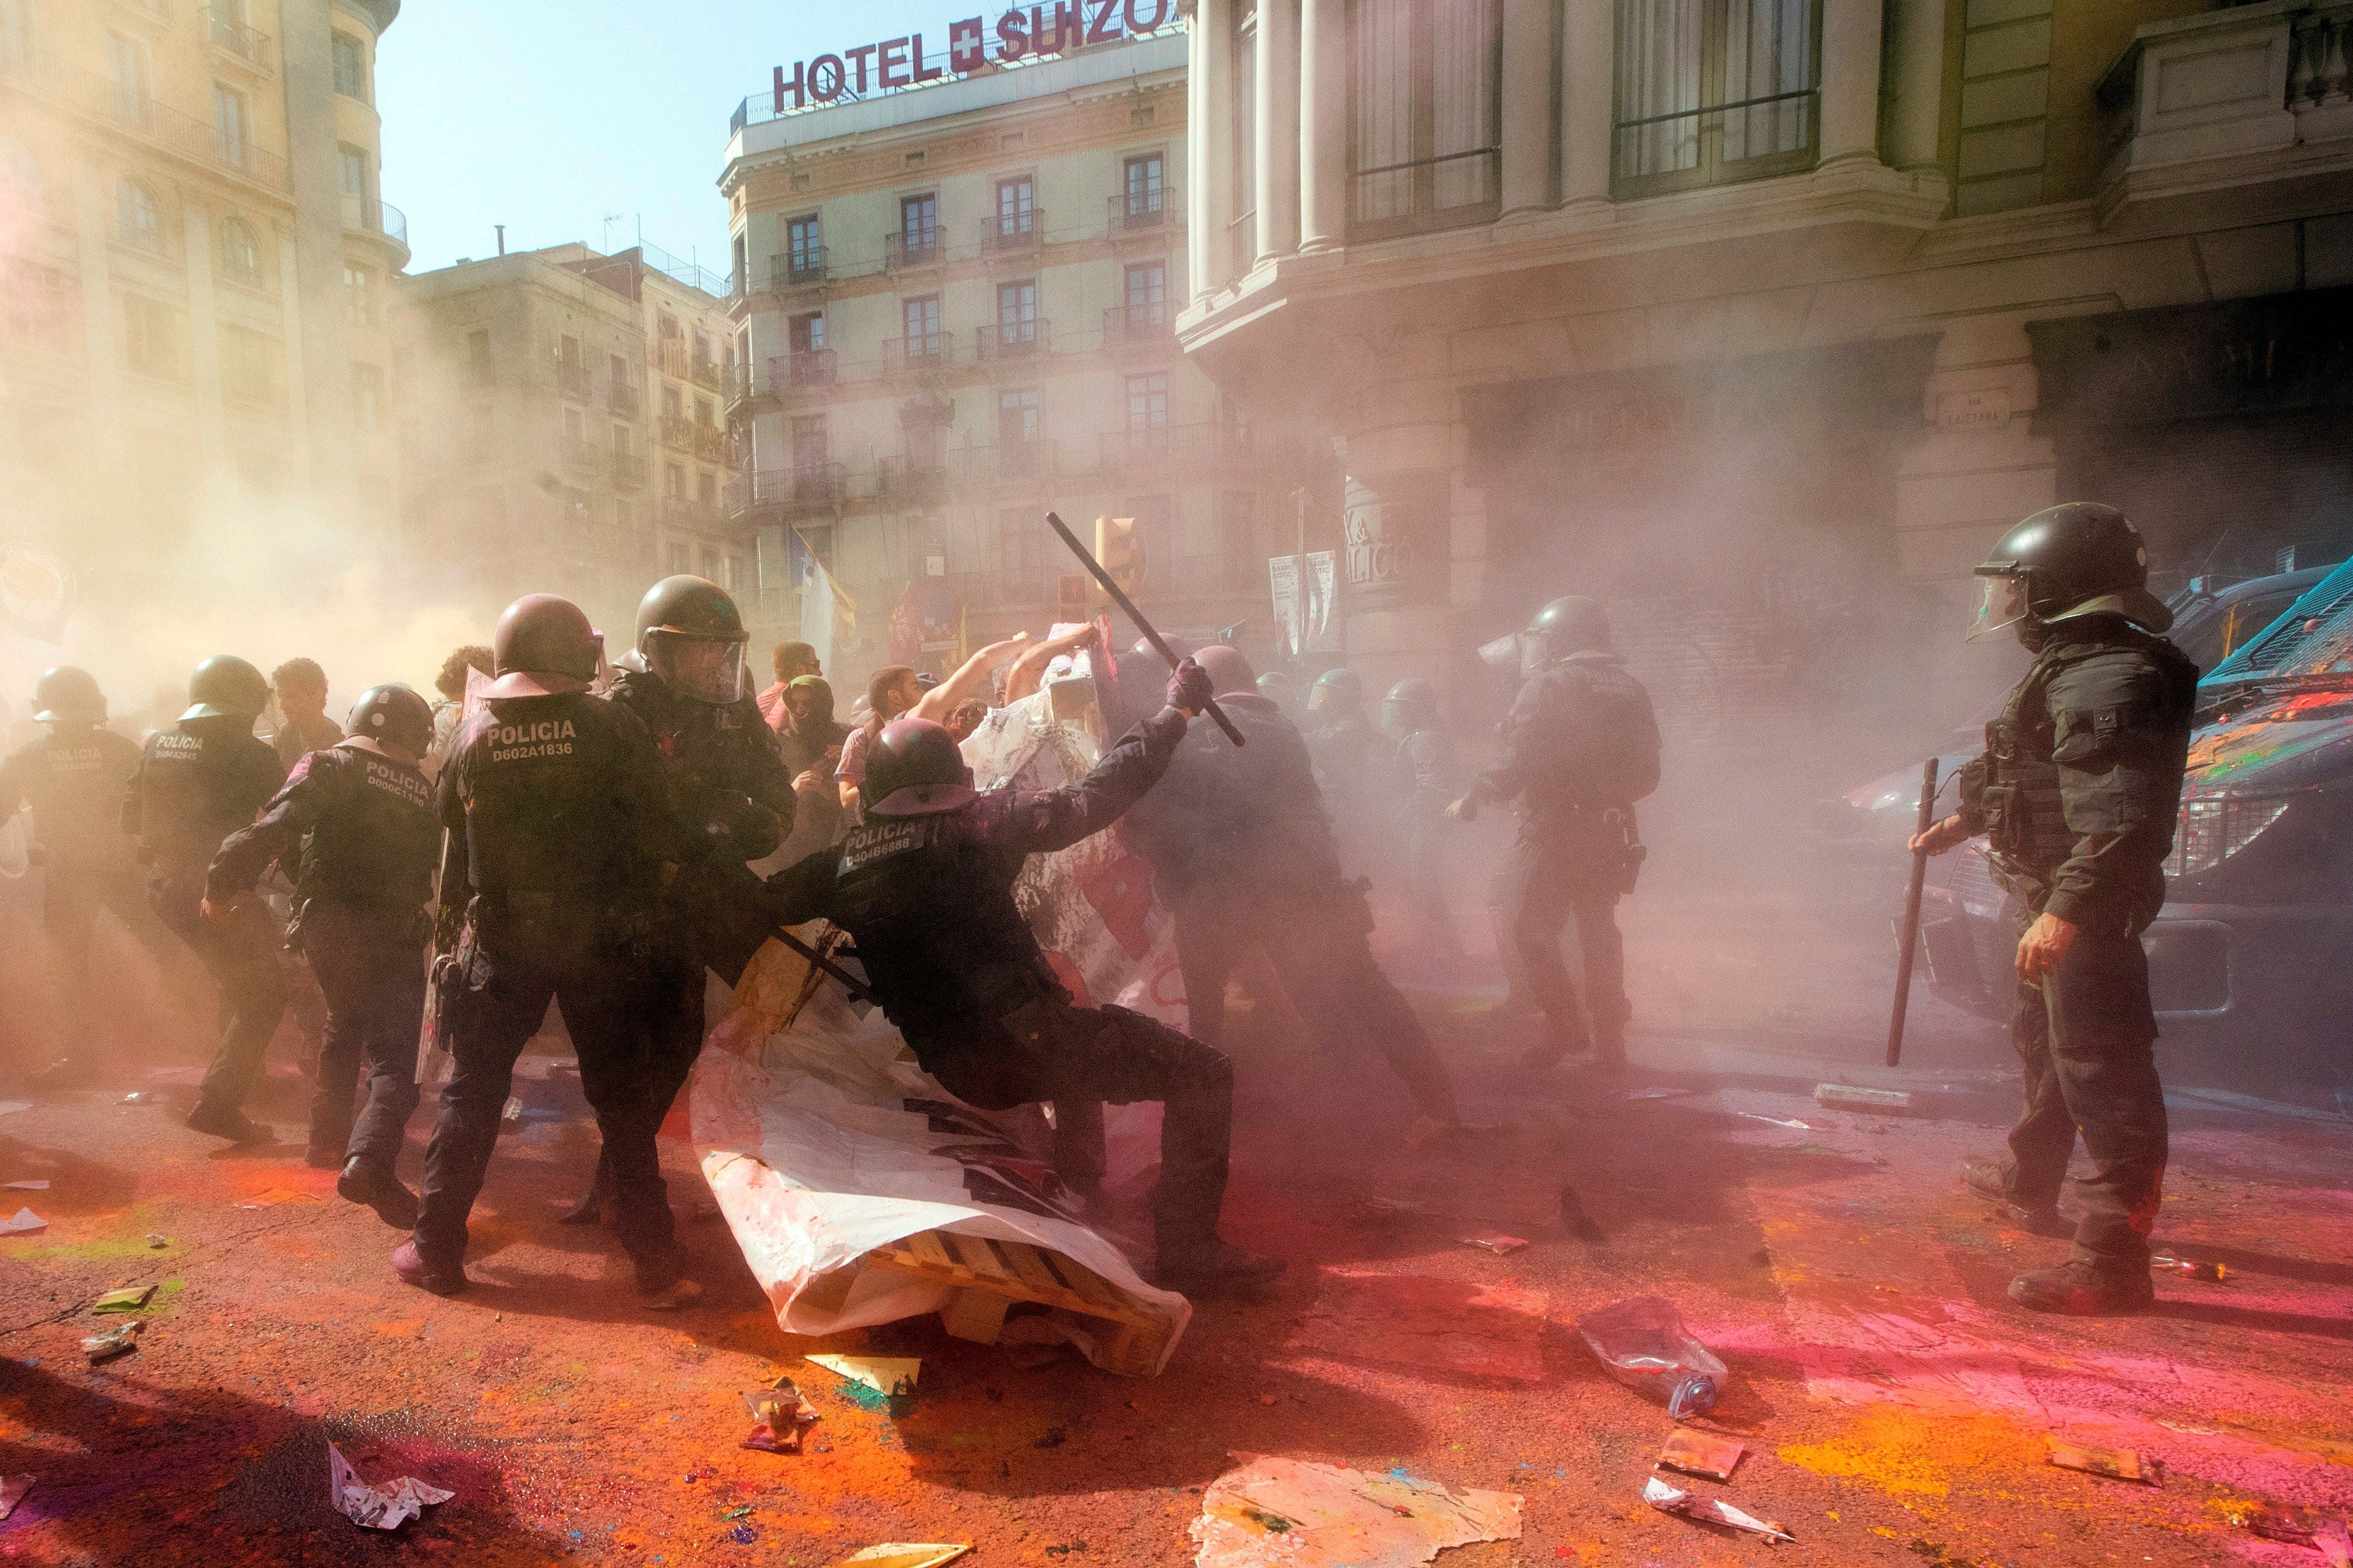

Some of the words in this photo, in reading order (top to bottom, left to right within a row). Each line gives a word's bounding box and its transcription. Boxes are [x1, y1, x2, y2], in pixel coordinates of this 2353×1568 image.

[773, 33, 943, 113] HOTEL
[995, 0, 1169, 63] SUIZO
[1271, 564, 1291, 573] BARRI
[156, 735, 203, 750] POLICIA
[487, 719, 576, 747] POLICIA
[493, 743, 573, 762] D602A1836
[366, 761, 429, 800] POLICIA
[845, 822, 916, 855] POLICIA
